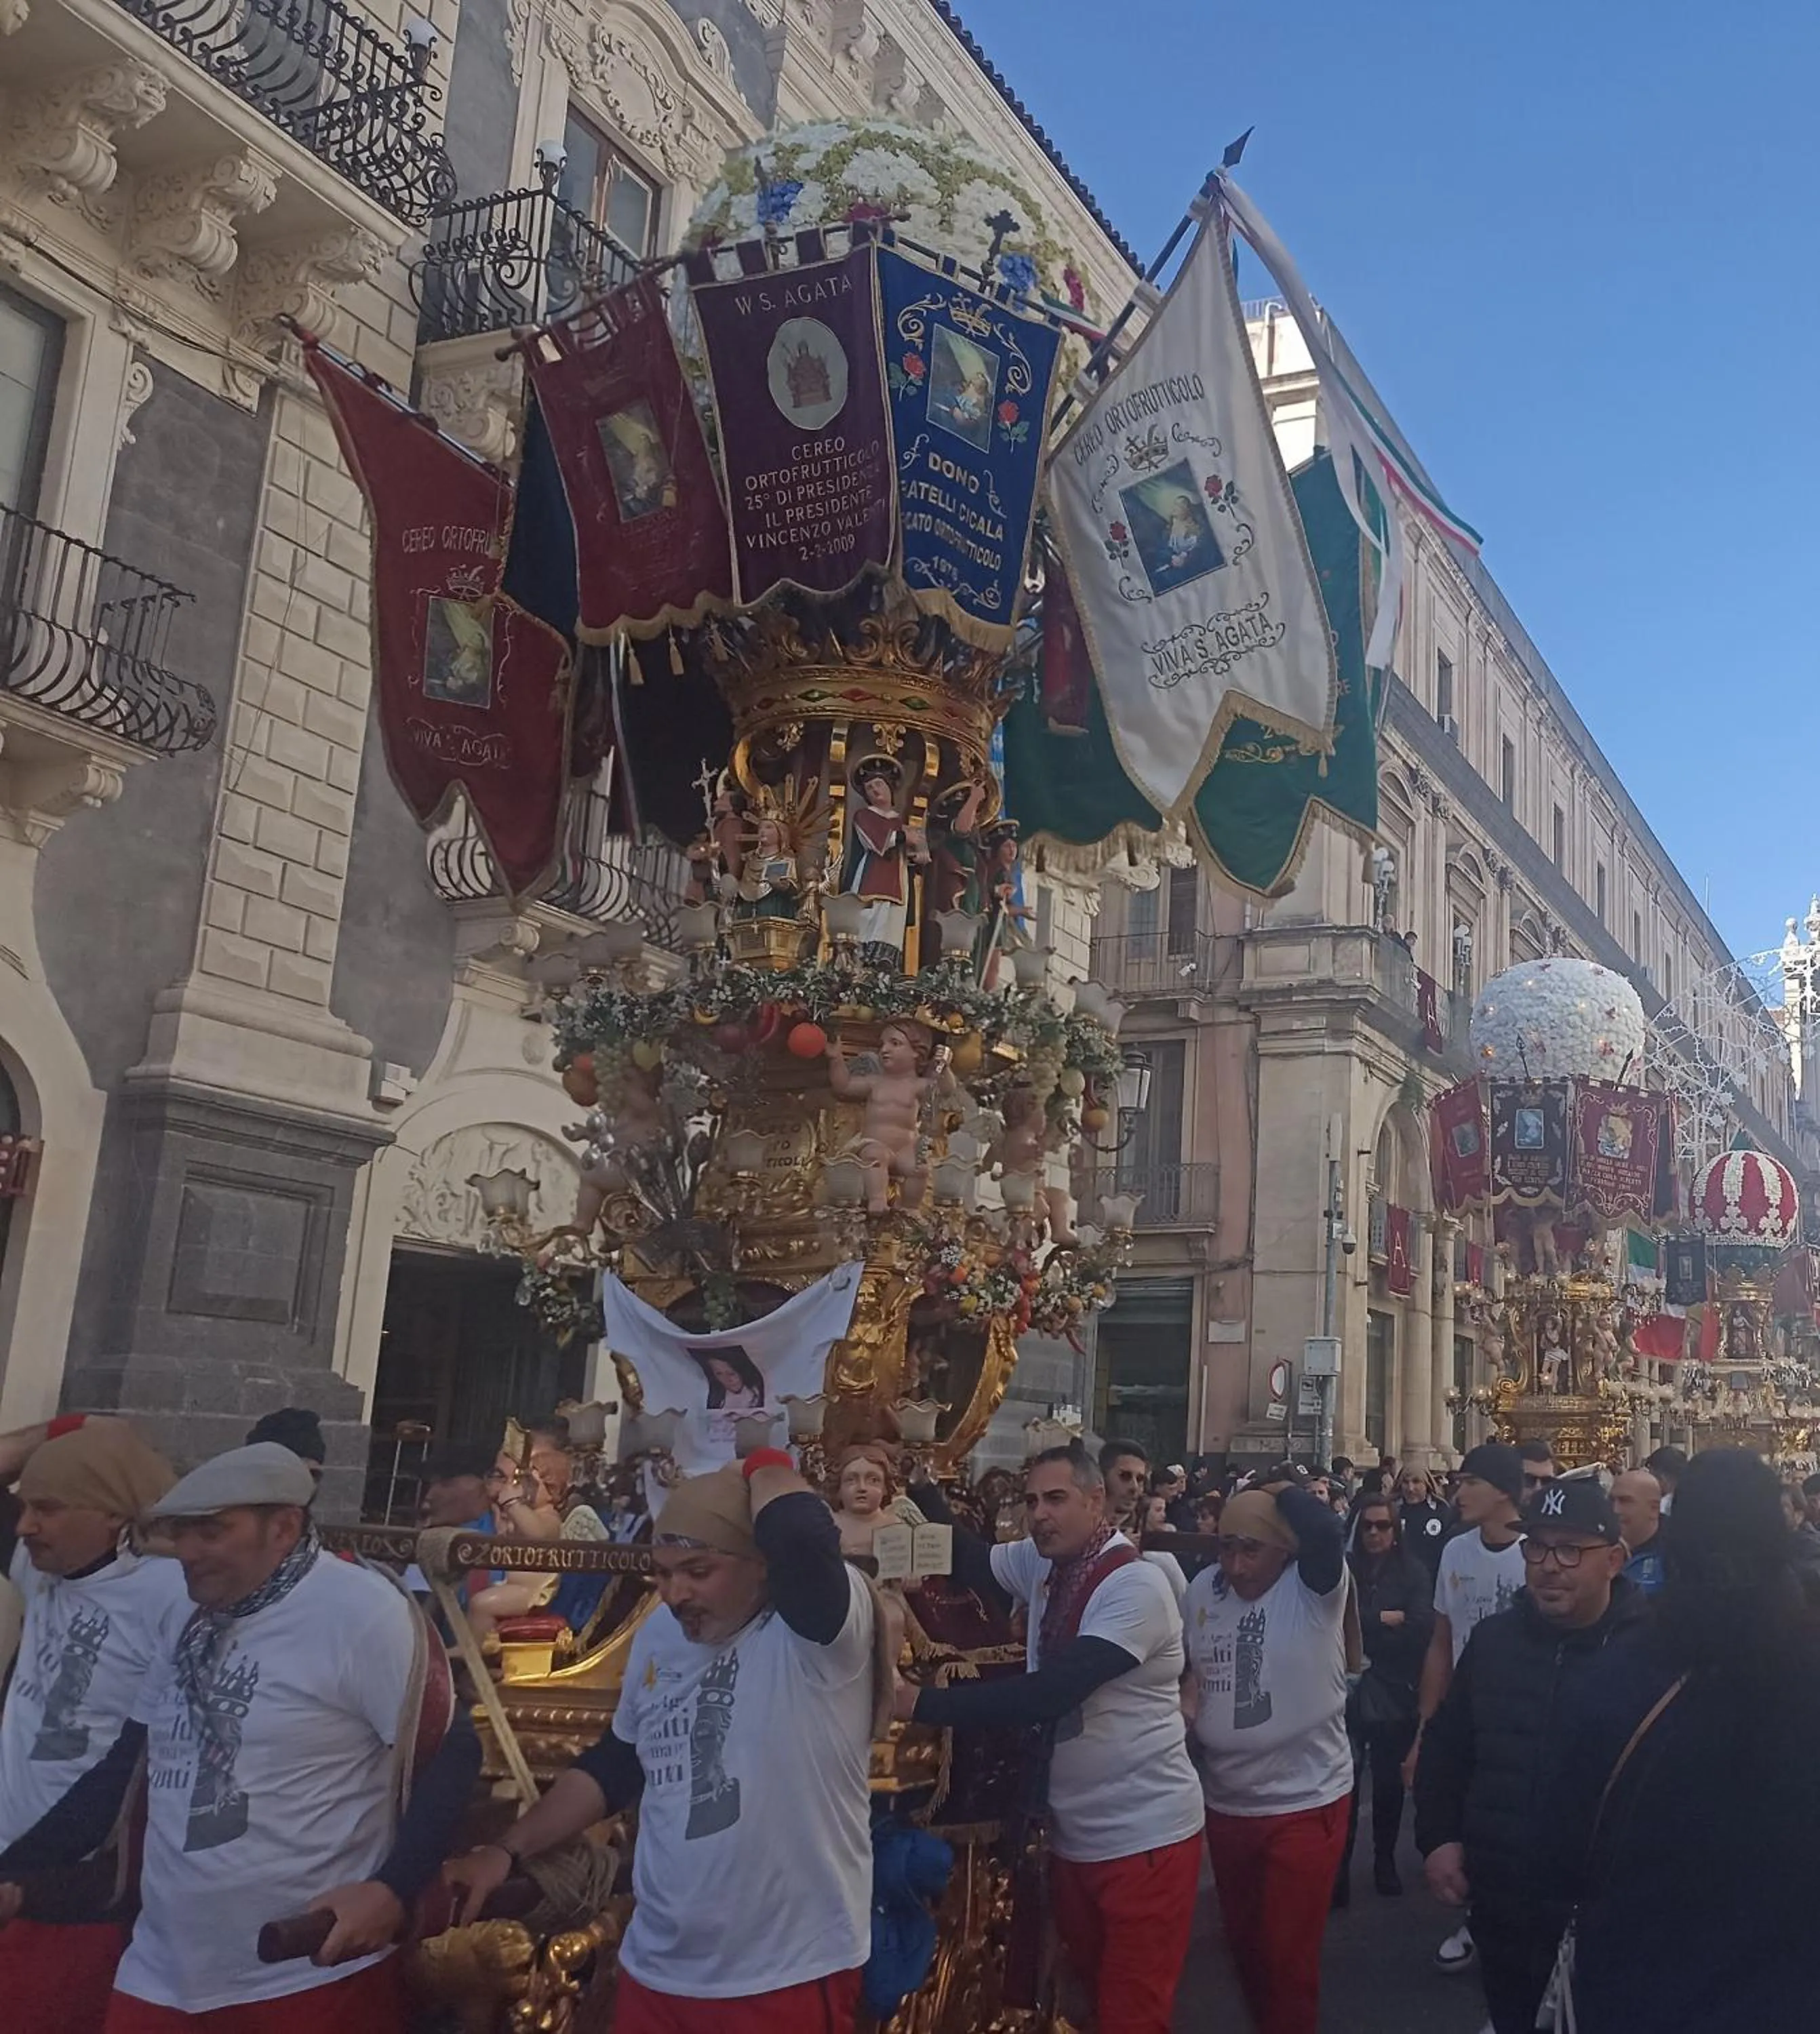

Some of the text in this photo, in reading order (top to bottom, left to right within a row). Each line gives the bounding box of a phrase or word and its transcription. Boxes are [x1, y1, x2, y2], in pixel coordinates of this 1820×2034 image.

[734, 274, 852, 315] W S. AGATA
[1105, 374, 1205, 435] ORTOFRUTTICOLO
[745, 440, 879, 490] ORTOFRUTTICOLO
[791, 436, 846, 461] CEREO
[928, 452, 981, 494] DONO
[745, 493, 771, 510] 25°
[776, 489, 792, 505] DI
[765, 484, 872, 528] IL PRESIDENTE
[746, 498, 886, 549] VINCENZO VALETI
[958, 503, 1004, 542] CICALA
[1151, 647, 1194, 676] VIVA
[1214, 612, 1274, 652] AGATA
[1541, 1489, 1566, 1515] NY
[490, 1545, 651, 1572] ORTOFRUTTICOLO
